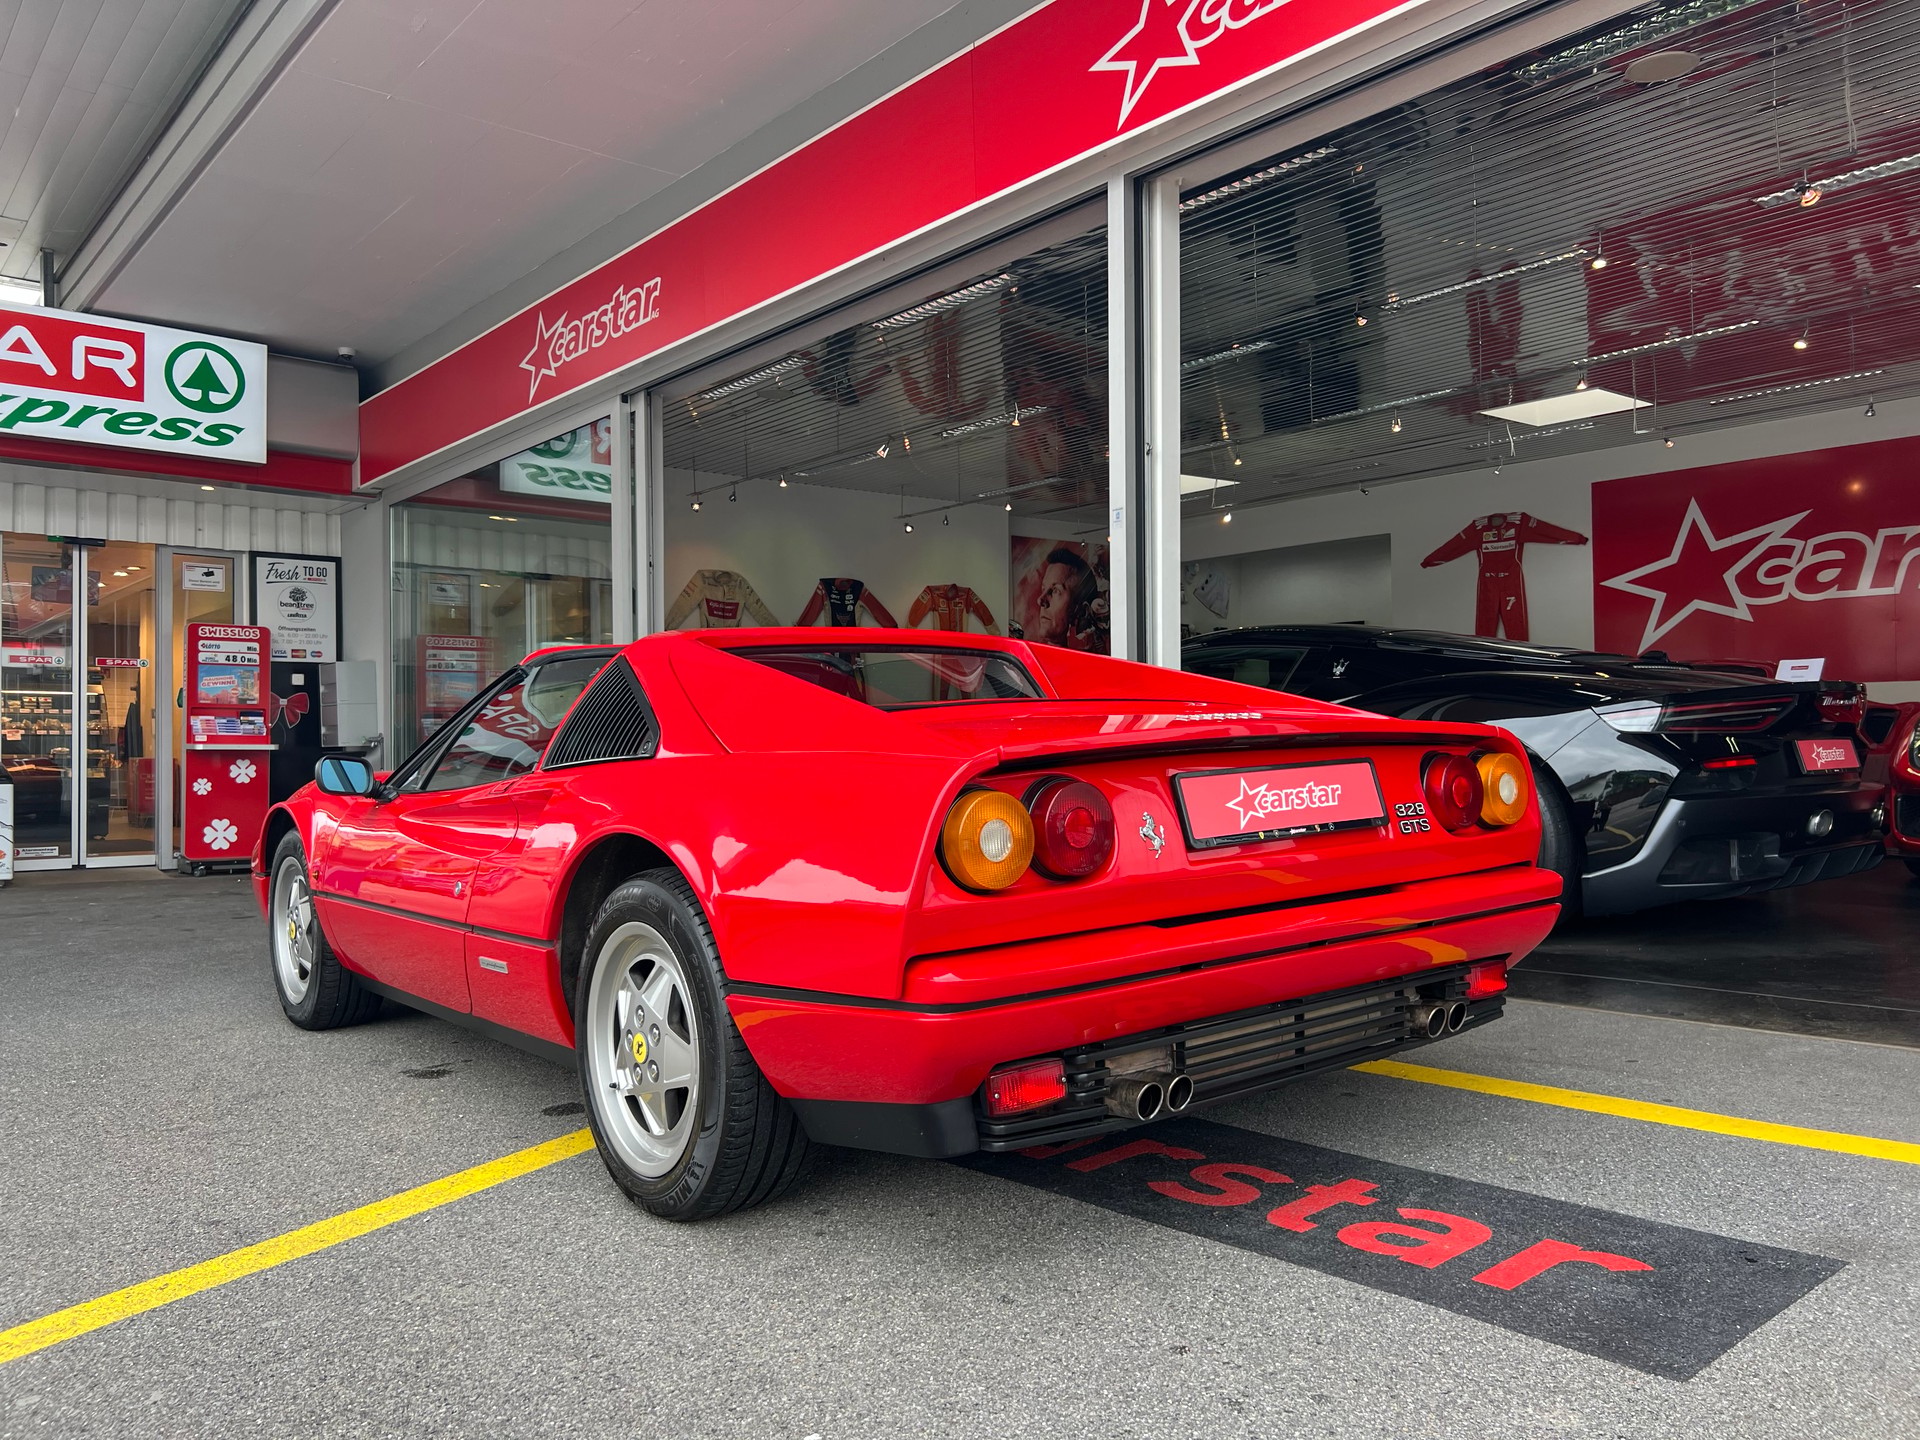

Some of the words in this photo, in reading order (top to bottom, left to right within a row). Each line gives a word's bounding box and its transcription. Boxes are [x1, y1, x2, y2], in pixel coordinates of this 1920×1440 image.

[552, 277, 661, 367] carstar
[650, 308, 660, 320] AG
[266, 562, 301, 580] Fresh
[303, 566, 314, 577] TO
[316, 567, 327, 578] GO
[1505, 596, 1516, 611] 7
[199, 627, 259, 638] SWISSLOS
[1820, 747, 1845, 761] carstar
[1259, 781, 1341, 813] carstar
[1395, 802, 1426, 816] 328
[1400, 819, 1431, 833] GTS
